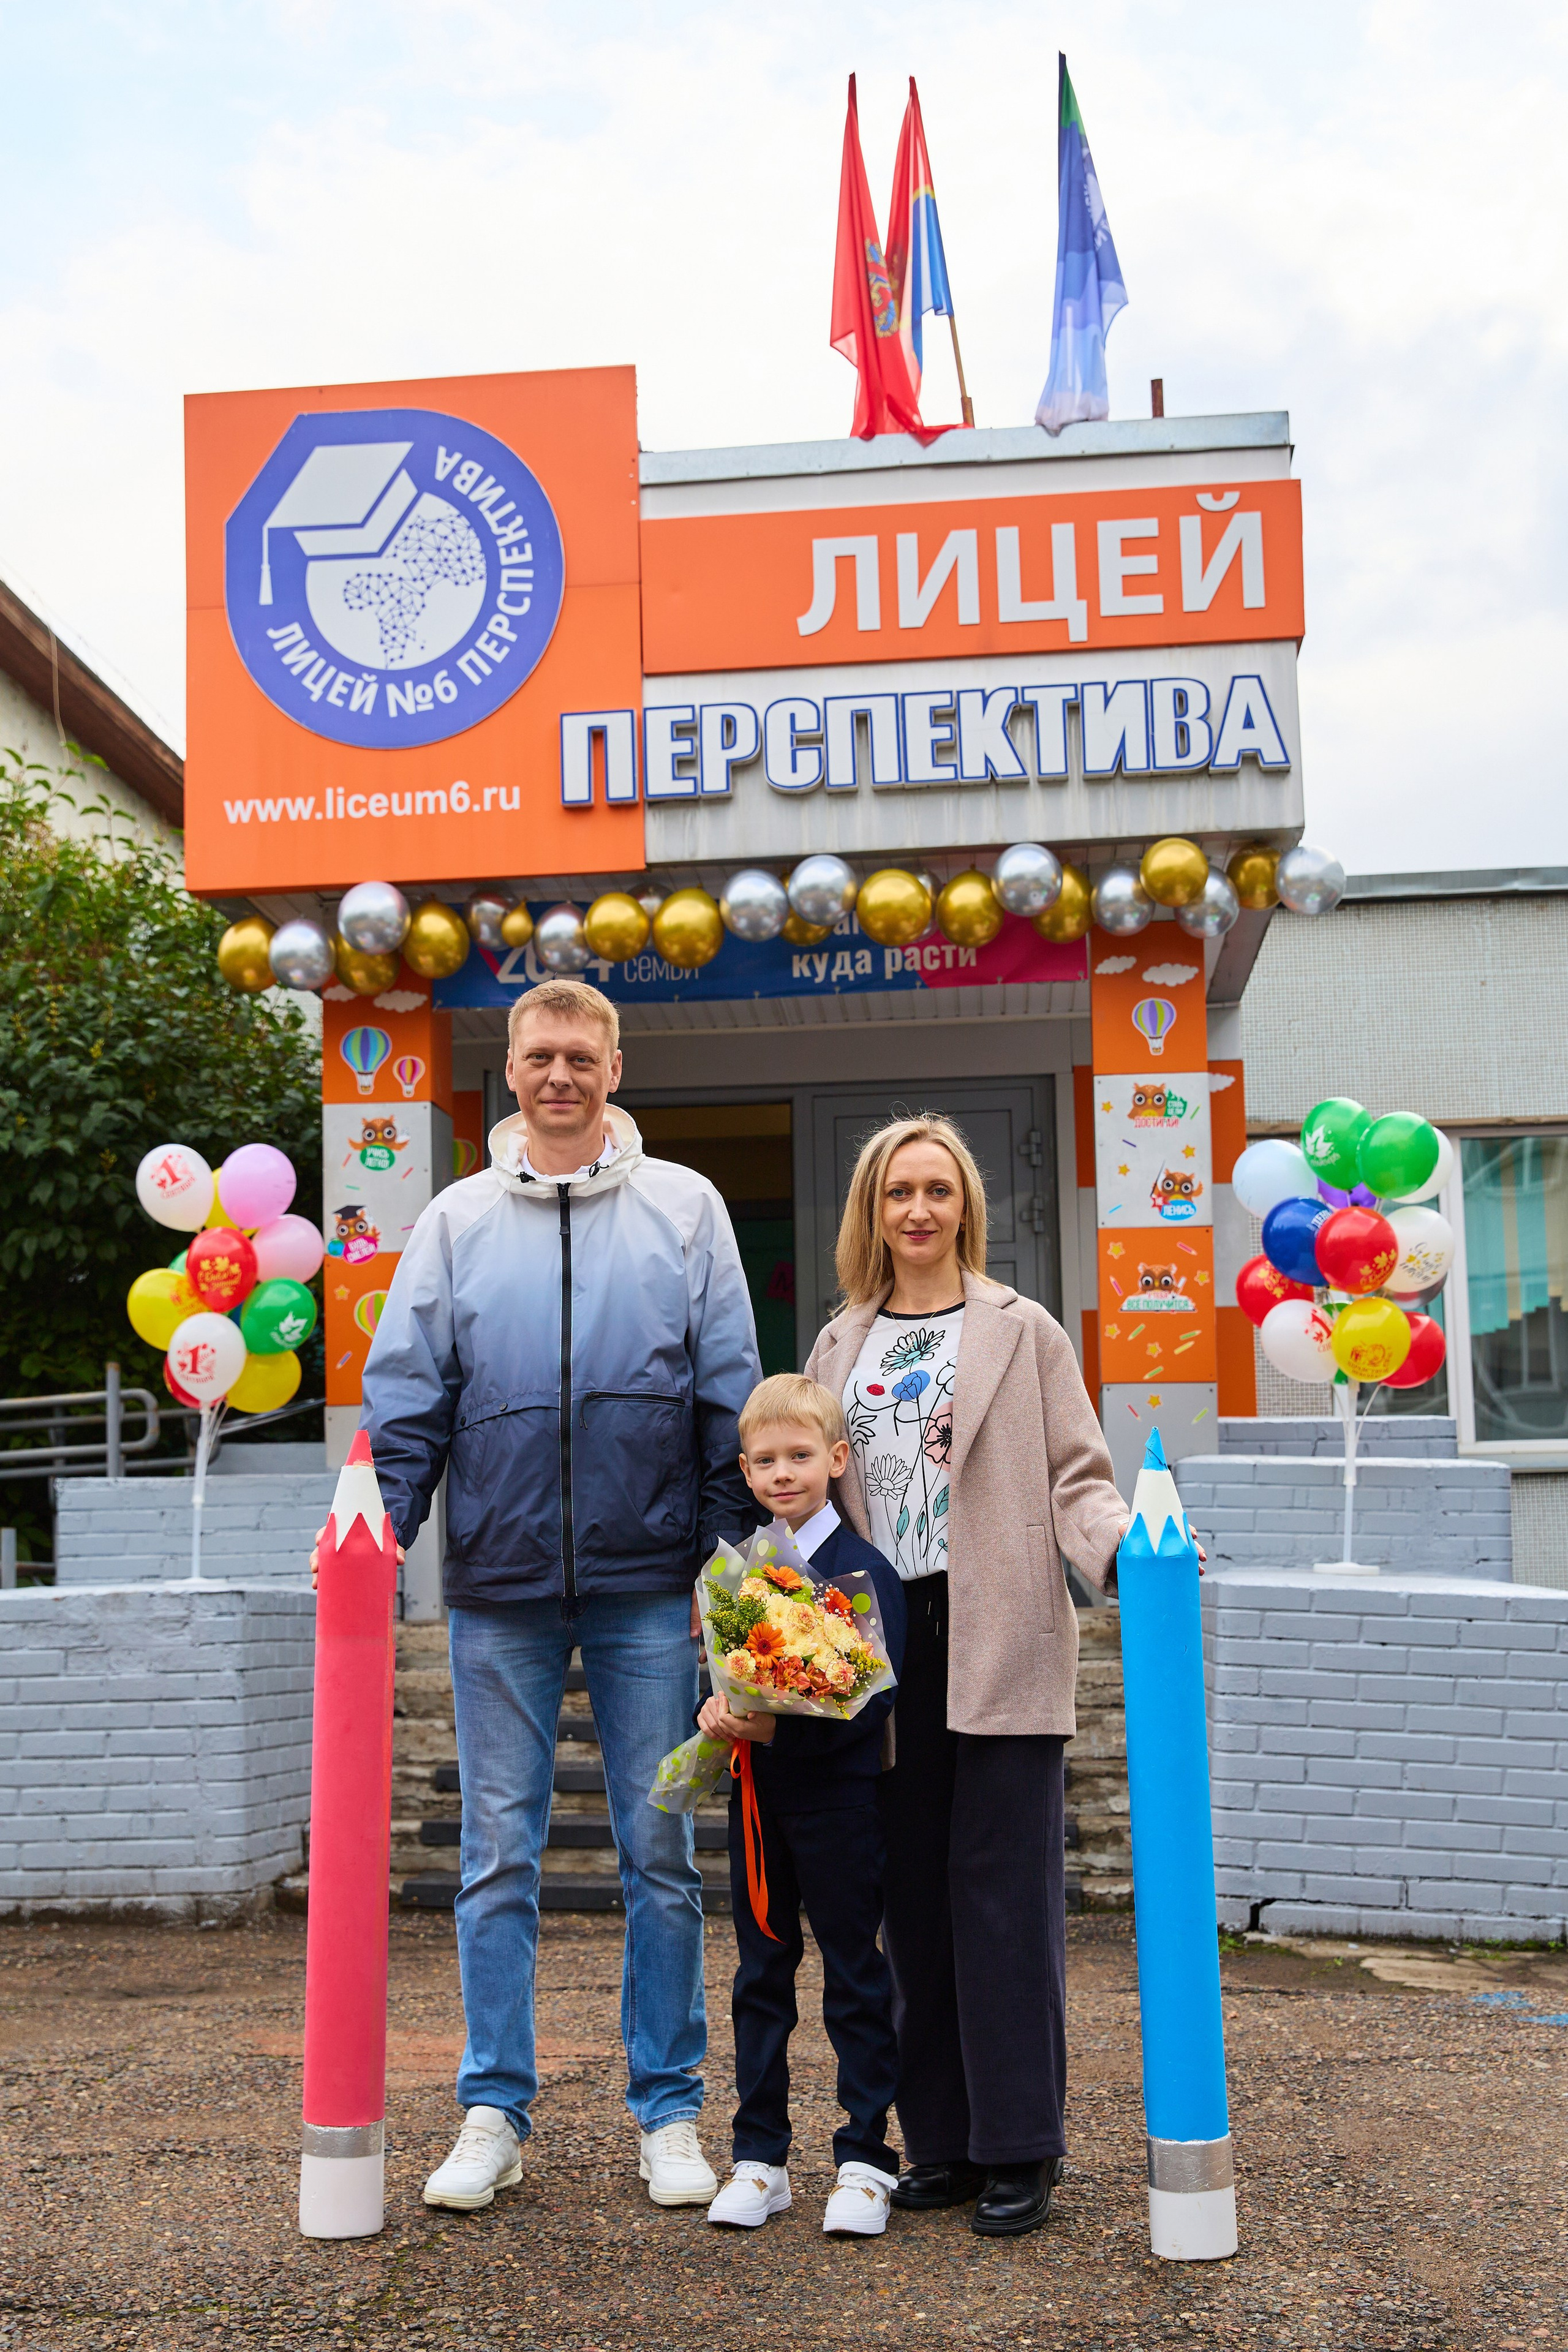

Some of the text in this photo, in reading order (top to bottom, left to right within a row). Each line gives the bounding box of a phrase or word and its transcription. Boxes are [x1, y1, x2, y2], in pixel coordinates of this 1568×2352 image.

[266, 445, 534, 718] ЛИЦЕЙ №6 ПЕРСПЕКТИВА
[796, 491, 1265, 643] ЛИЦЕЙ
[560, 674, 1291, 809] ПЕРСПЕКТИВА
[223, 780, 521, 824] www.liceum6.ru
[792, 944, 977, 984] куда расти
[1163, 1204, 1195, 1216] ЛЕНИСЬ
